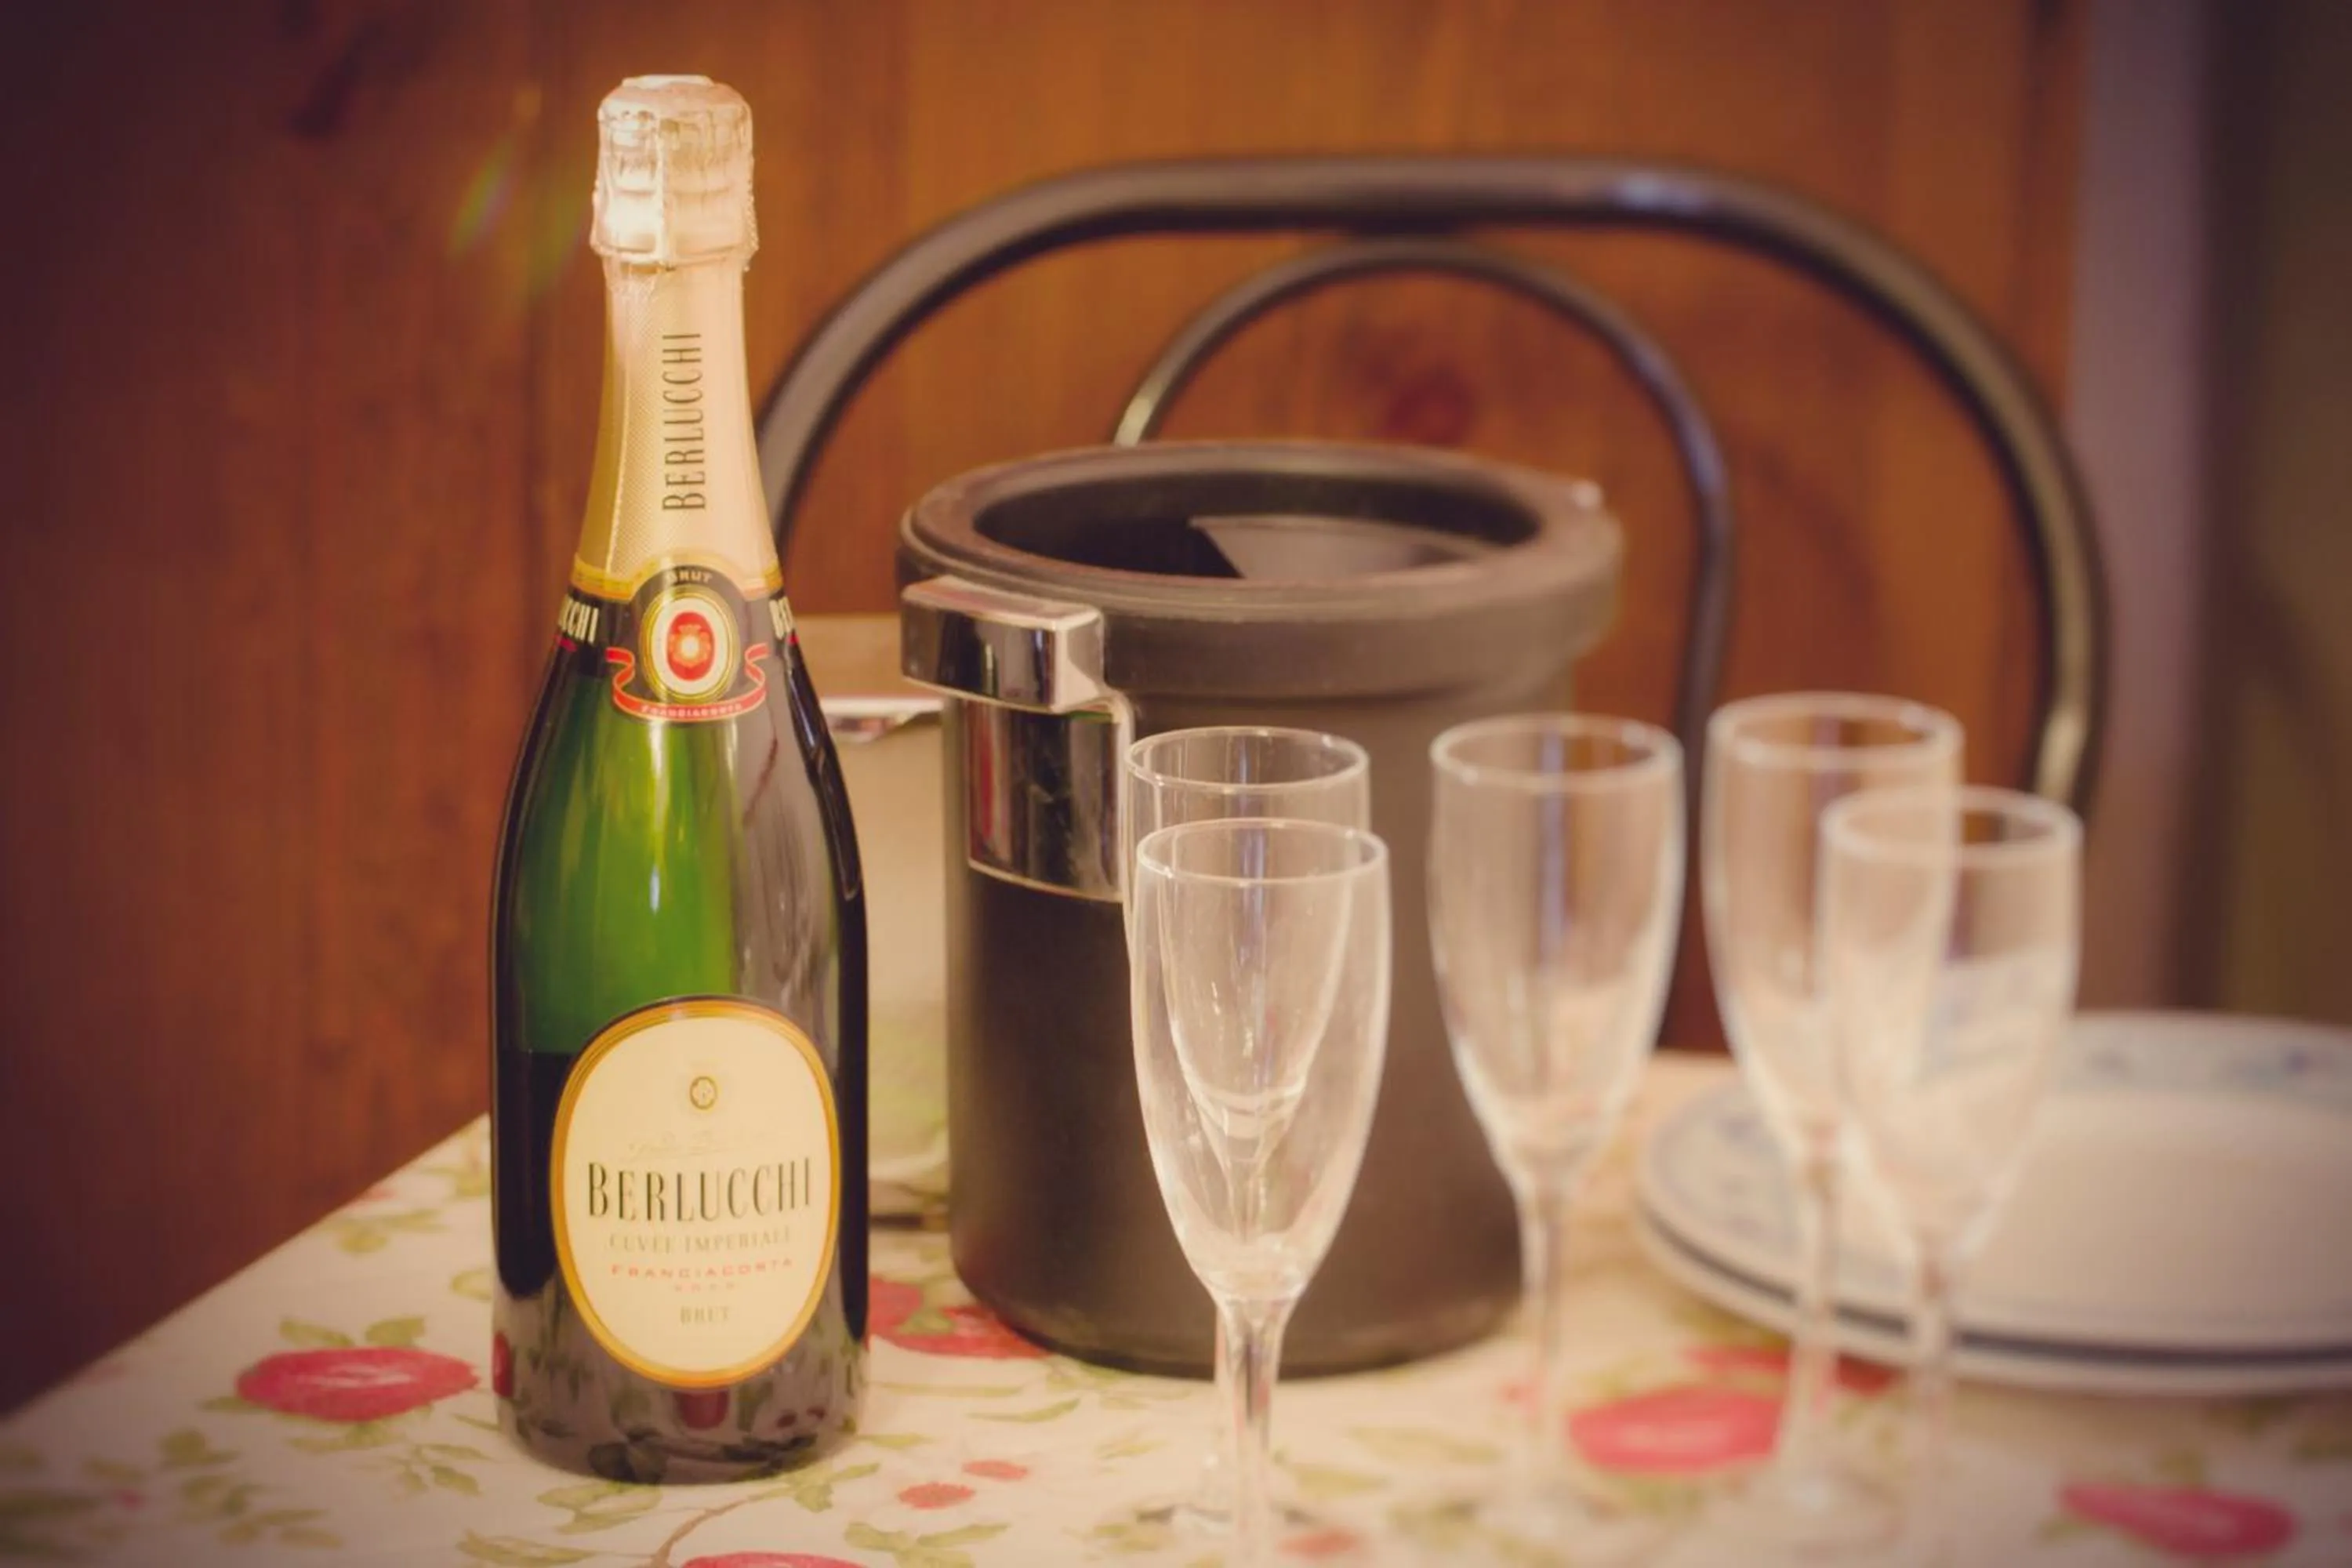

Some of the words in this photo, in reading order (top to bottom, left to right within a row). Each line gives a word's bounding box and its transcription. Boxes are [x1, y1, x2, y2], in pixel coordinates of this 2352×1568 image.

[662, 334, 705, 510] BERLUCCHI
[666, 569, 713, 585] BRUT
[588, 1156, 811, 1221] BERLUCCHI
[679, 1305, 731, 1325] BRUT
